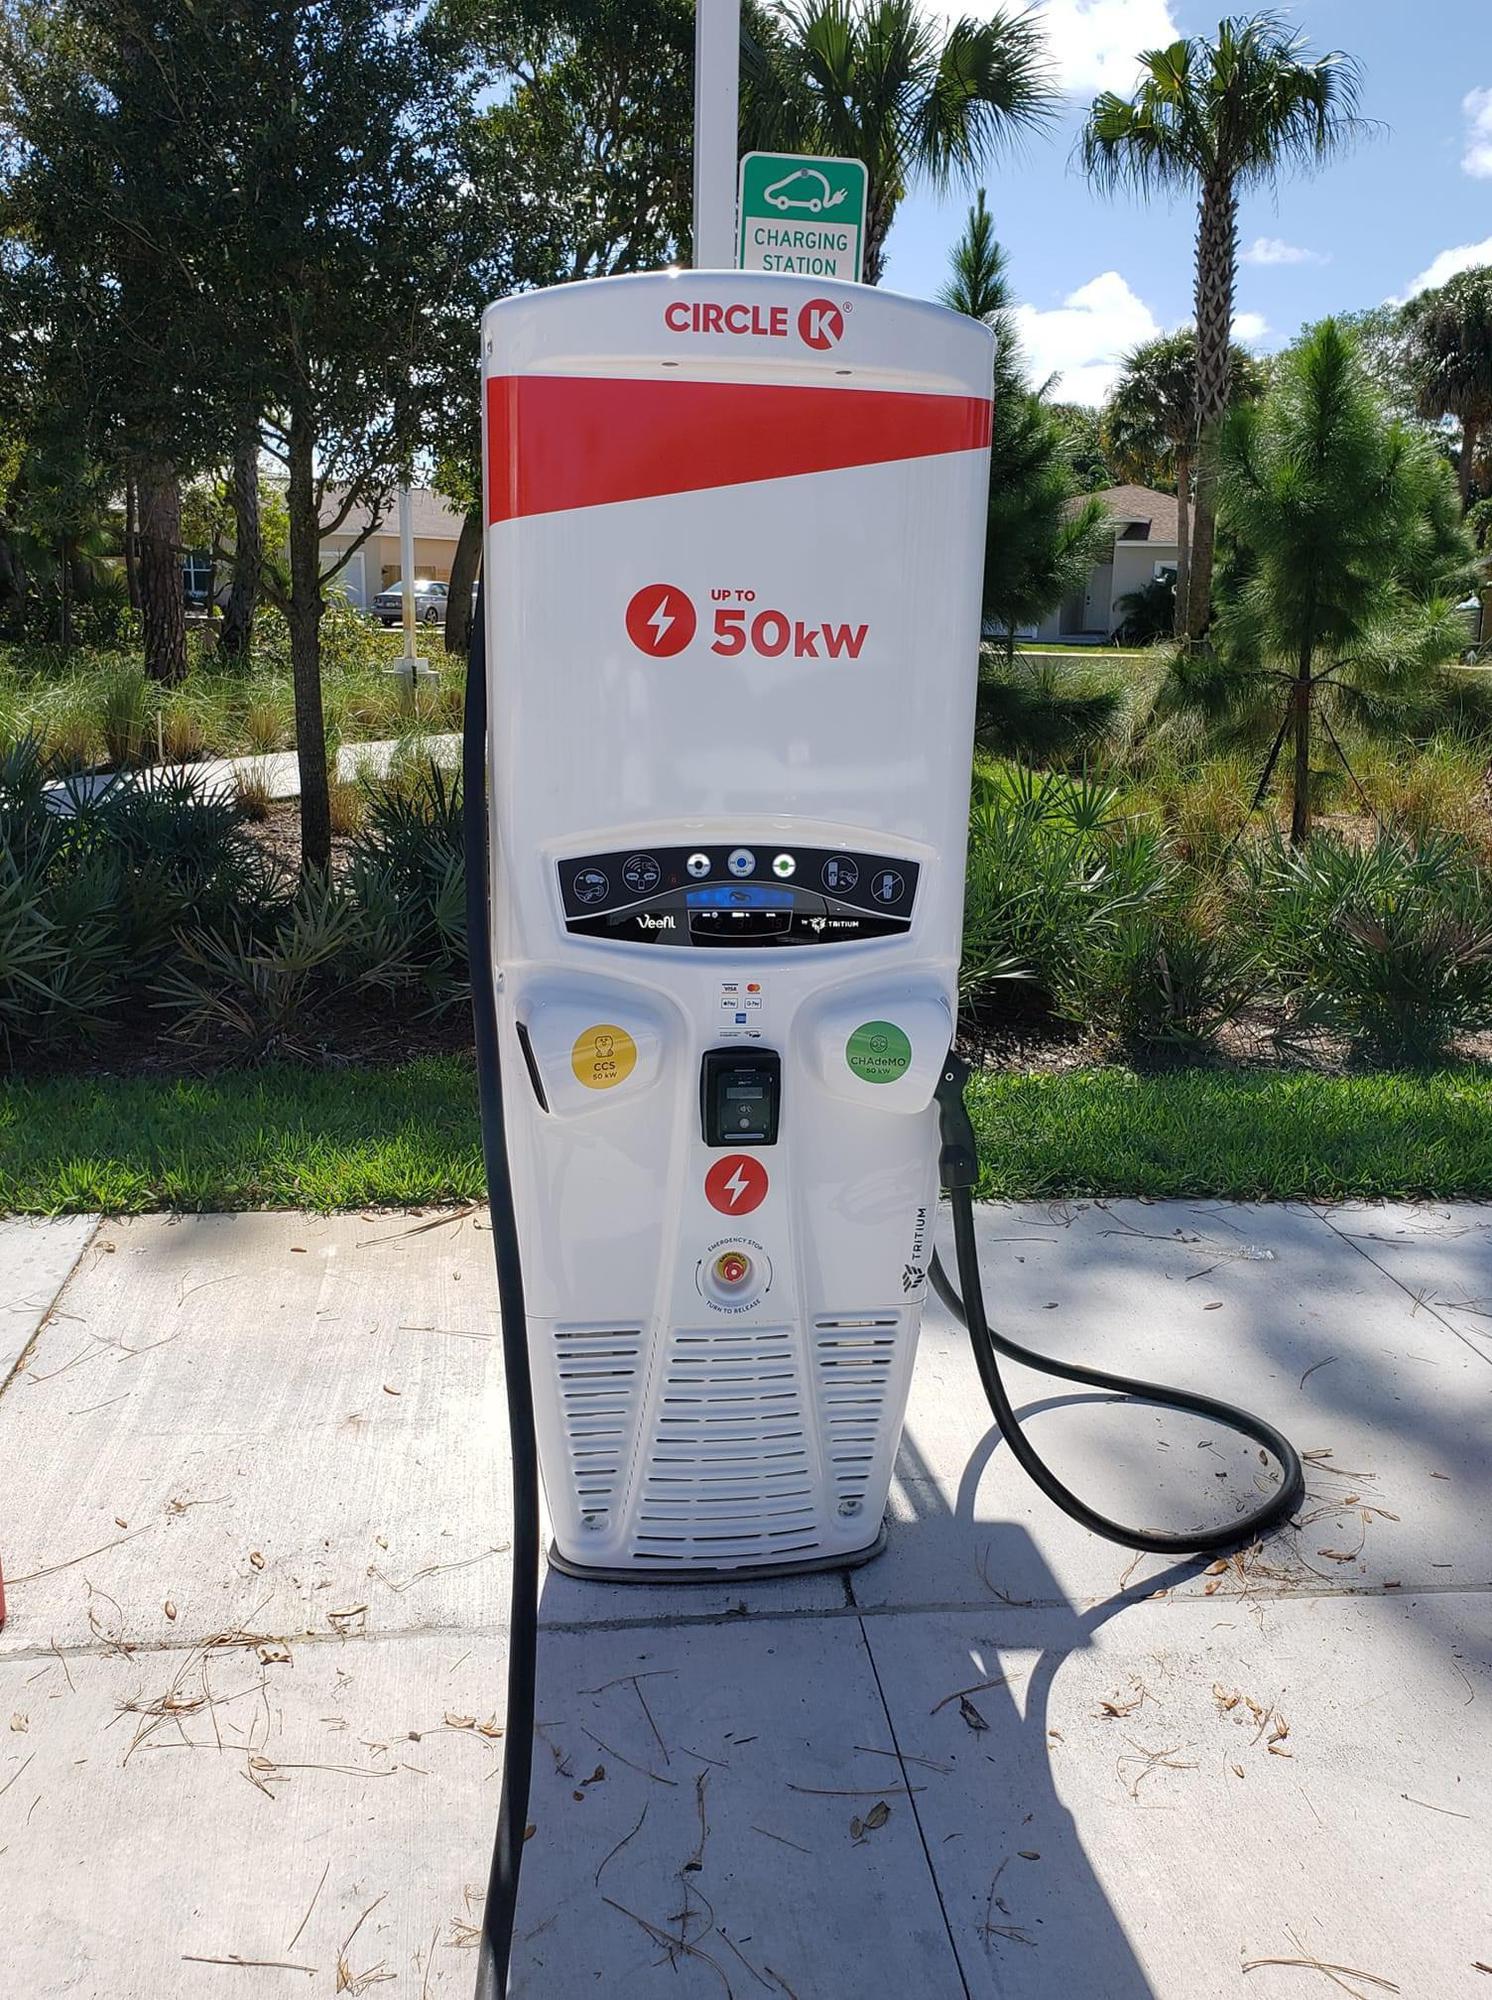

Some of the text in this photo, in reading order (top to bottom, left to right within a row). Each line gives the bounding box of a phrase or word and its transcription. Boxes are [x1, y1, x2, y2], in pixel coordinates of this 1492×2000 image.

[754, 228, 848, 251] CHARGING
[762, 254, 836, 276] STATION
[664, 302, 842, 348] CIRCLE K
[710, 589, 756, 602] UP TO
[710, 609, 869, 658] 50kW
[828, 920, 859, 928] TRITIUM
[593, 1061, 616, 1071] CCS
[850, 1056, 906, 1067] CHAdeMO
[592, 1073, 603, 1081] 50
[912, 1208, 927, 1260] TRITIUM
[707, 1236, 763, 1252] EMERGENCY STOP
[706, 1299, 761, 1315] TURN TO RELEASE
